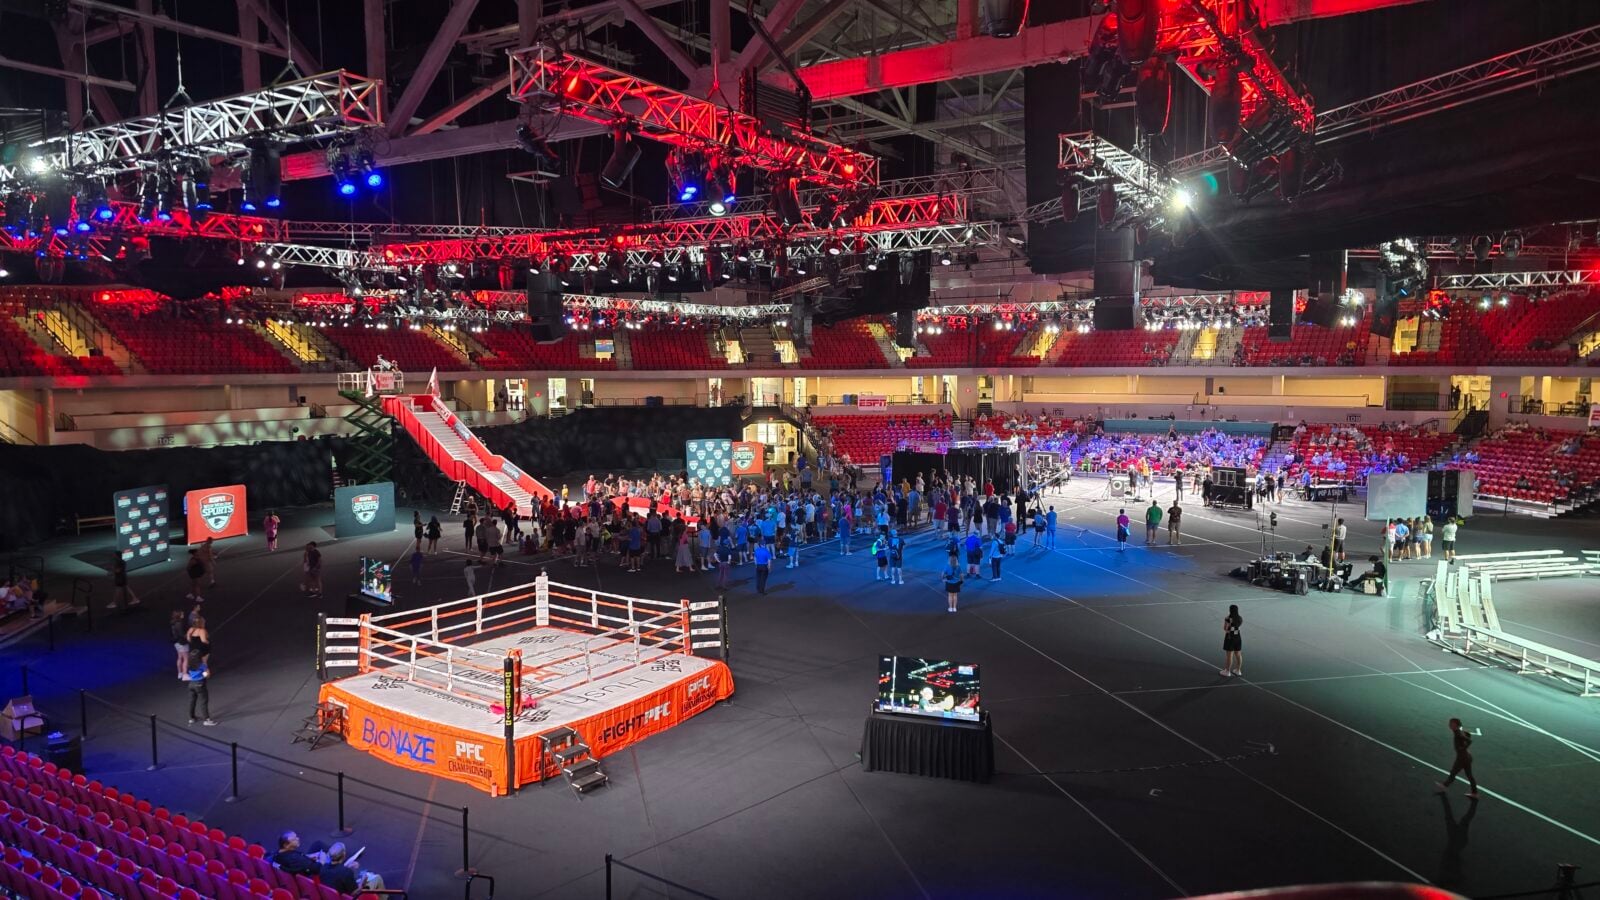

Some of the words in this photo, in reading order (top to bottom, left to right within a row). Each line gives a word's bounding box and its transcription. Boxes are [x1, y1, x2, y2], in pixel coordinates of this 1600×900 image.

[858, 399, 887, 407] ESPN
[202, 504, 234, 517] SPORTS
[353, 503, 379, 512] SPORTS
[687, 675, 711, 697] PFC
[455, 740, 485, 762] PFC
[448, 760, 493, 780] CHAMPIONSHIP
